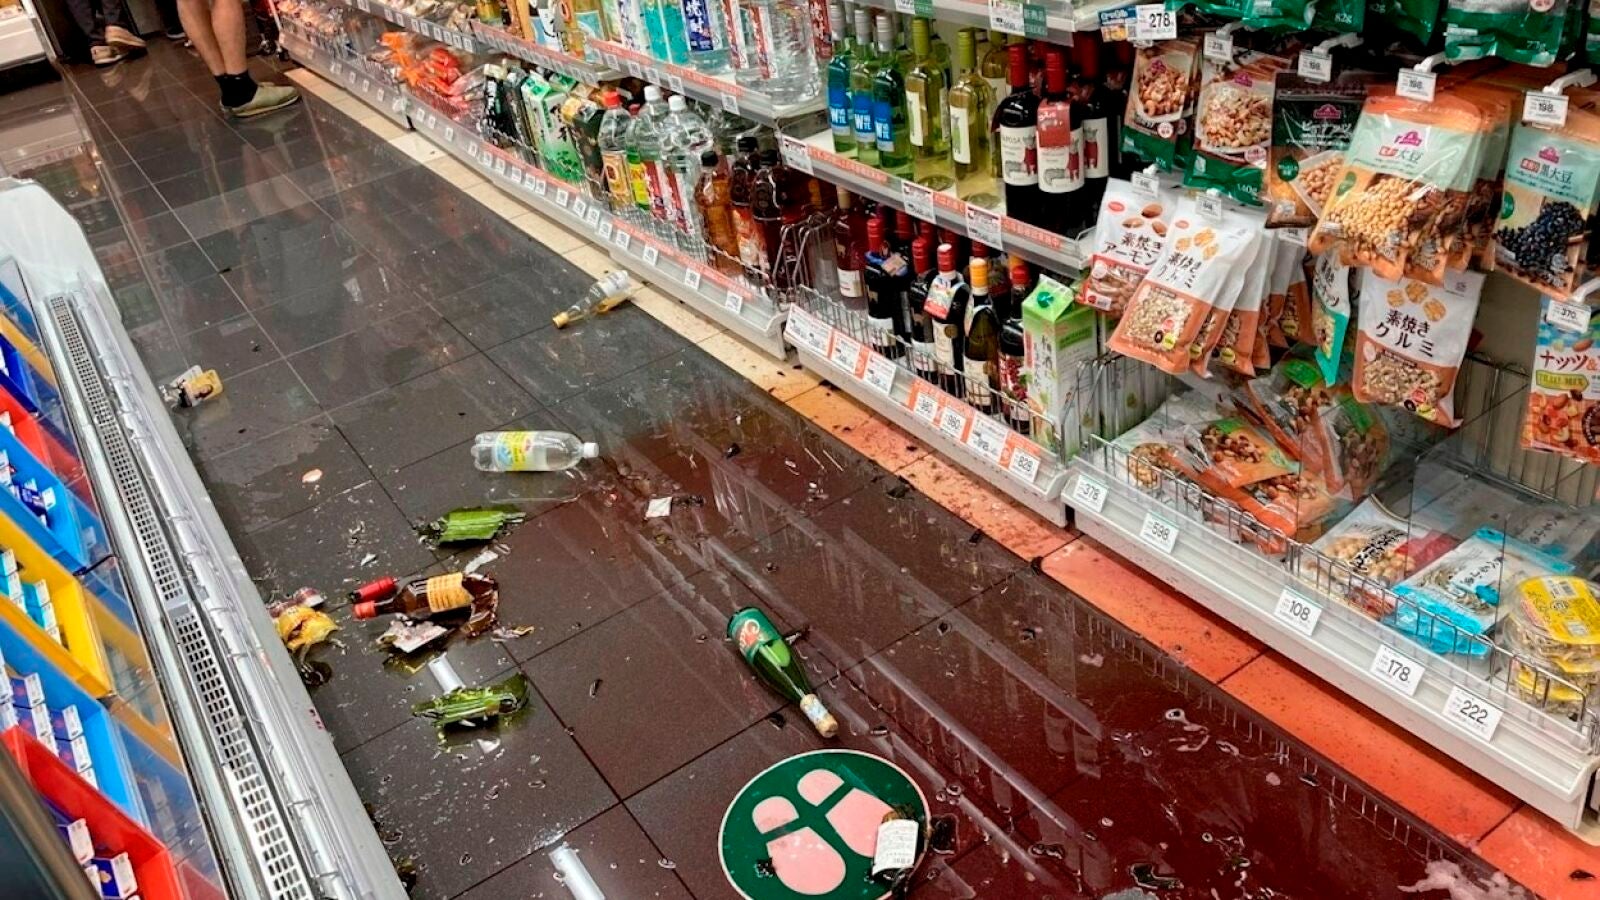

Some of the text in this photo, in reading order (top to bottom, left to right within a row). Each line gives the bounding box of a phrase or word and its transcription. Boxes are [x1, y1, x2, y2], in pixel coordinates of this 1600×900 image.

[1149, 13, 1171, 28] 278
[1538, 103, 1554, 112] 198
[1385, 309, 1430, 338] 素焼き
[1376, 322, 1434, 357] クルミ
[1151, 521, 1170, 541] 598
[1289, 600, 1311, 621] 108
[1387, 659, 1411, 682] 178
[1460, 700, 1488, 724] 222
